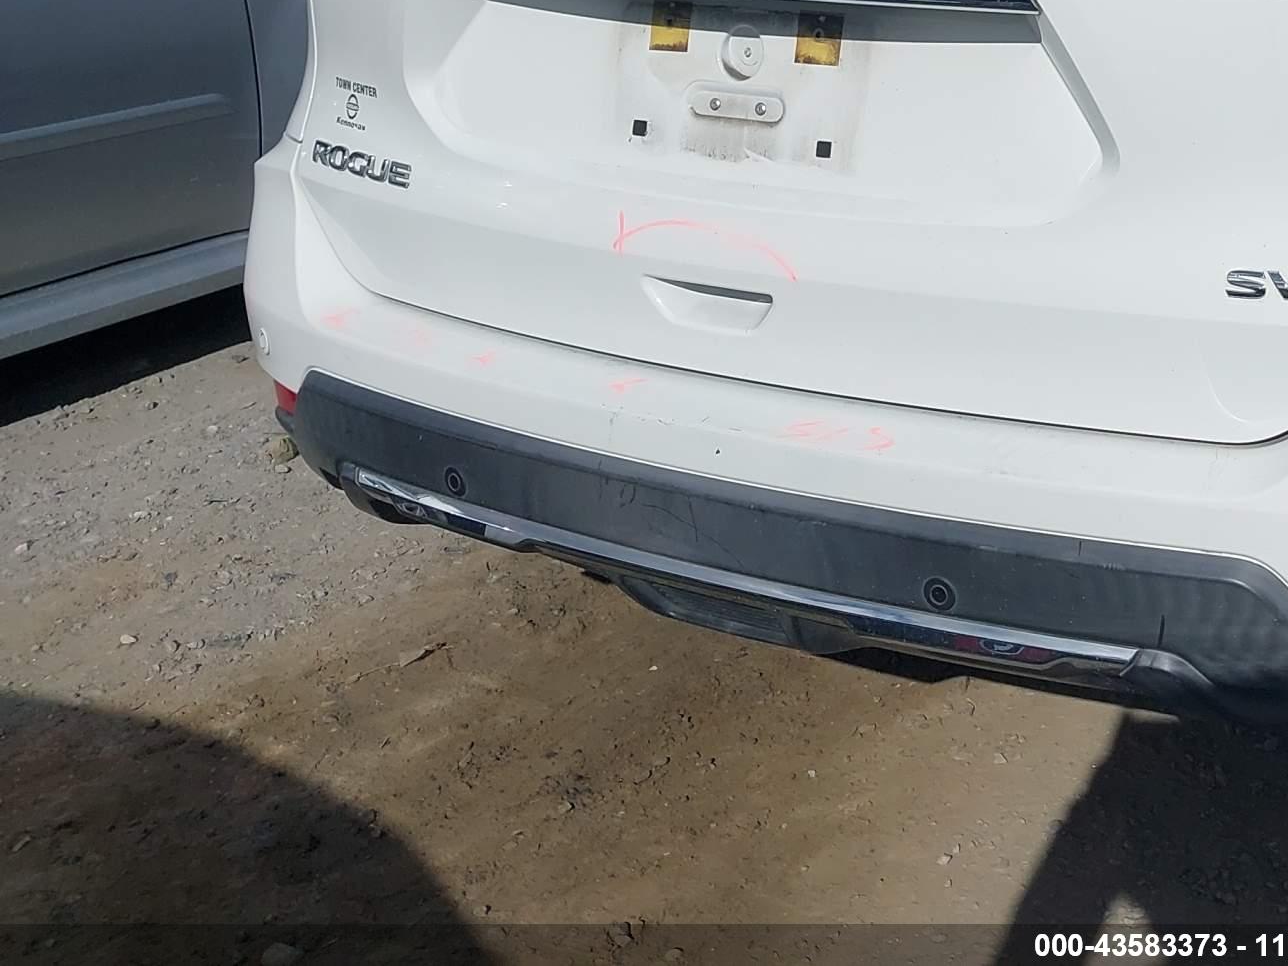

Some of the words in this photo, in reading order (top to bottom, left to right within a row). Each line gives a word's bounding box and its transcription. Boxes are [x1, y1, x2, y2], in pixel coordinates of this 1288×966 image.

[335, 76, 351, 91] TOWN
[352, 81, 377, 98] CENTER
[312, 140, 412, 189] ROGUE
